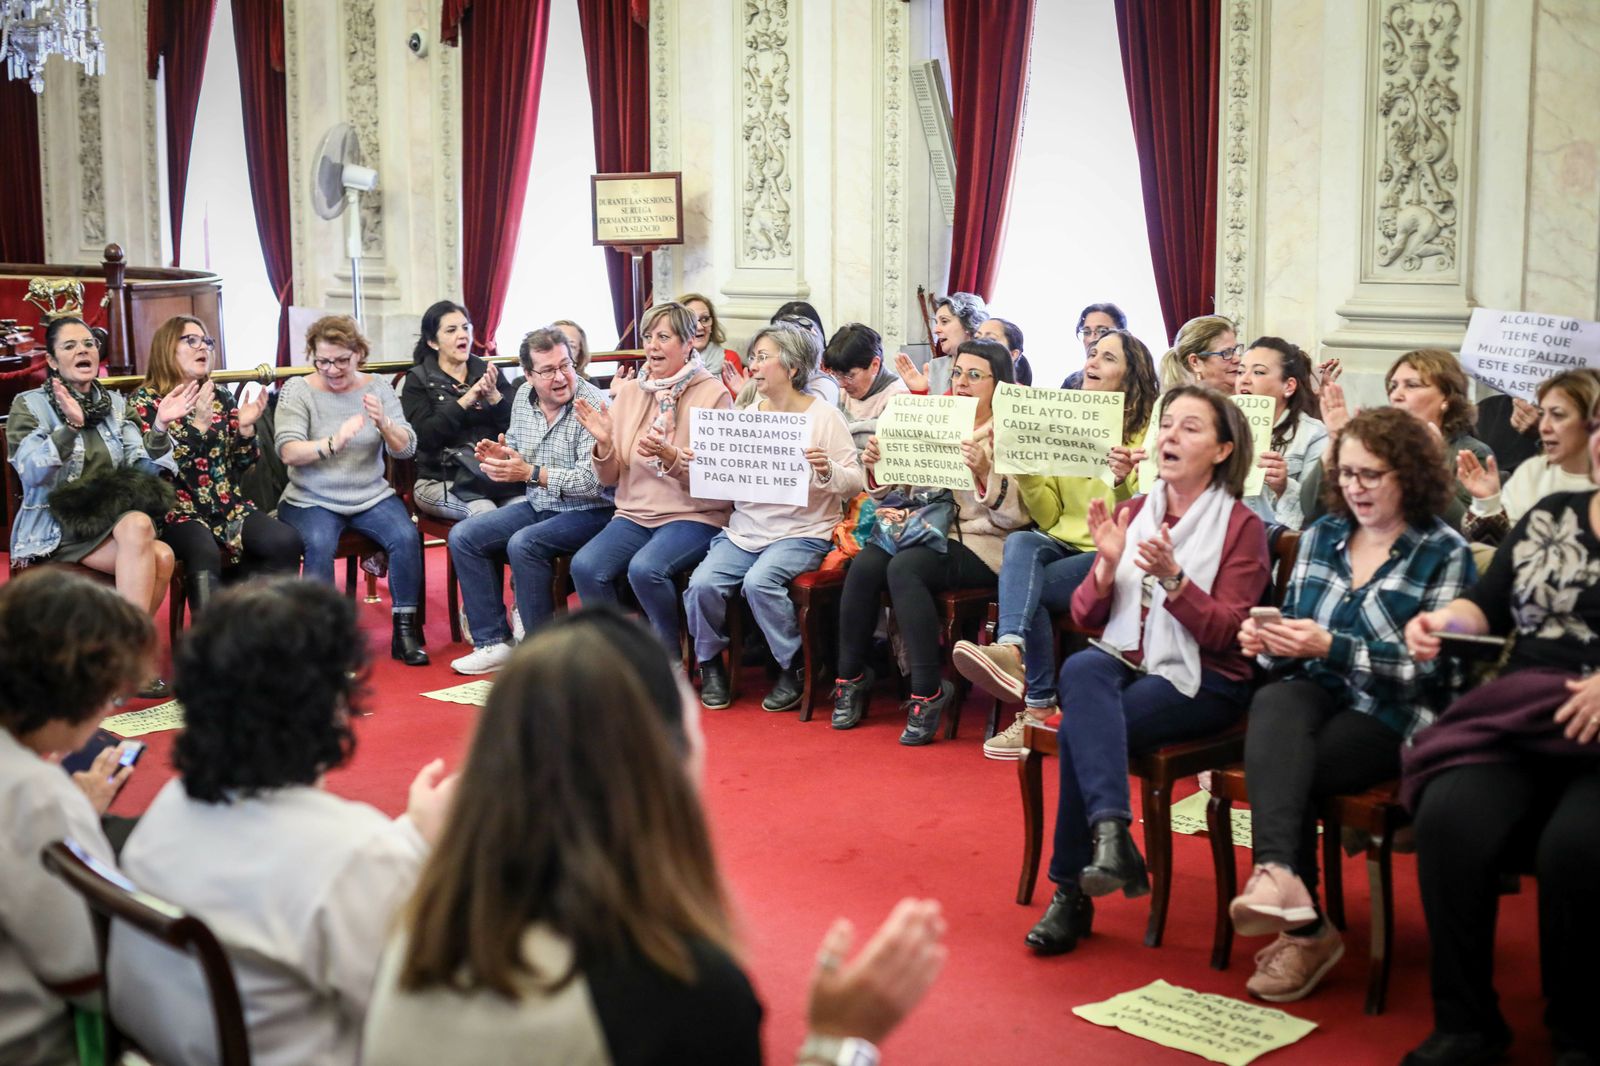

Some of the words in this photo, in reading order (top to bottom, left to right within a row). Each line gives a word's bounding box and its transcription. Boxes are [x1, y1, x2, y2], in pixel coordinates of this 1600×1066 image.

[599, 198, 629, 206] DURANTE
[599, 216, 642, 224] PERMANECER
[643, 215, 676, 223] SENTADOS
[630, 225, 660, 233] SILENCIO
[1500, 315, 1555, 328] ALCALDE
[1502, 330, 1538, 342] TIENE
[1542, 334, 1572, 348] QUE
[1478, 343, 1587, 368] MUNICIPALIZAR
[1478, 359, 1509, 372] ESTE
[1000, 386, 1020, 398] LAS
[1025, 390, 1120, 406] LIMPIADORAS
[698, 411, 714, 421] ¡SI
[718, 412, 735, 422] NO
[738, 413, 807, 426] COBRAMOS
[894, 412, 924, 423] TIENE
[926, 414, 950, 425] QUE
[1012, 404, 1035, 416] DEL
[1039, 407, 1078, 420] AYTO.
[1082, 411, 1099, 421] DE
[698, 426, 715, 436] NO
[719, 427, 802, 441] TRABAJAMOS!
[882, 428, 961, 440] MUNICIPALIZAR
[1003, 419, 1040, 432] CADIZ
[1049, 424, 1110, 438] ESTAMOS
[693, 441, 706, 450] 26
[710, 442, 725, 452] DE
[729, 444, 796, 456] DICIEMBRE
[886, 443, 909, 452] ESTE
[912, 444, 960, 455] SERVICIO
[1017, 435, 1040, 444] SIN
[1045, 436, 1096, 451] COBRAR
[696, 456, 717, 466] SIN
[720, 458, 768, 470] COBRAR
[772, 462, 785, 471] NI
[790, 463, 804, 472] LA
[1006, 450, 1048, 460] ¡KICHI
[1053, 452, 1088, 464] PAGA
[886, 458, 911, 468] PARA
[914, 458, 964, 472] ASEGURAR
[704, 472, 735, 483] PAGA
[738, 475, 752, 484] NI
[756, 476, 770, 486] EL
[773, 477, 798, 487] MES
[883, 472, 907, 482] QUE
[907, 474, 970, 488] COBRAREMOS
[1122, 1004, 1142, 1015] LA
[1139, 995, 1276, 1042] MUNICIPALIZAR
[1229, 1011, 1266, 1026] QUE
